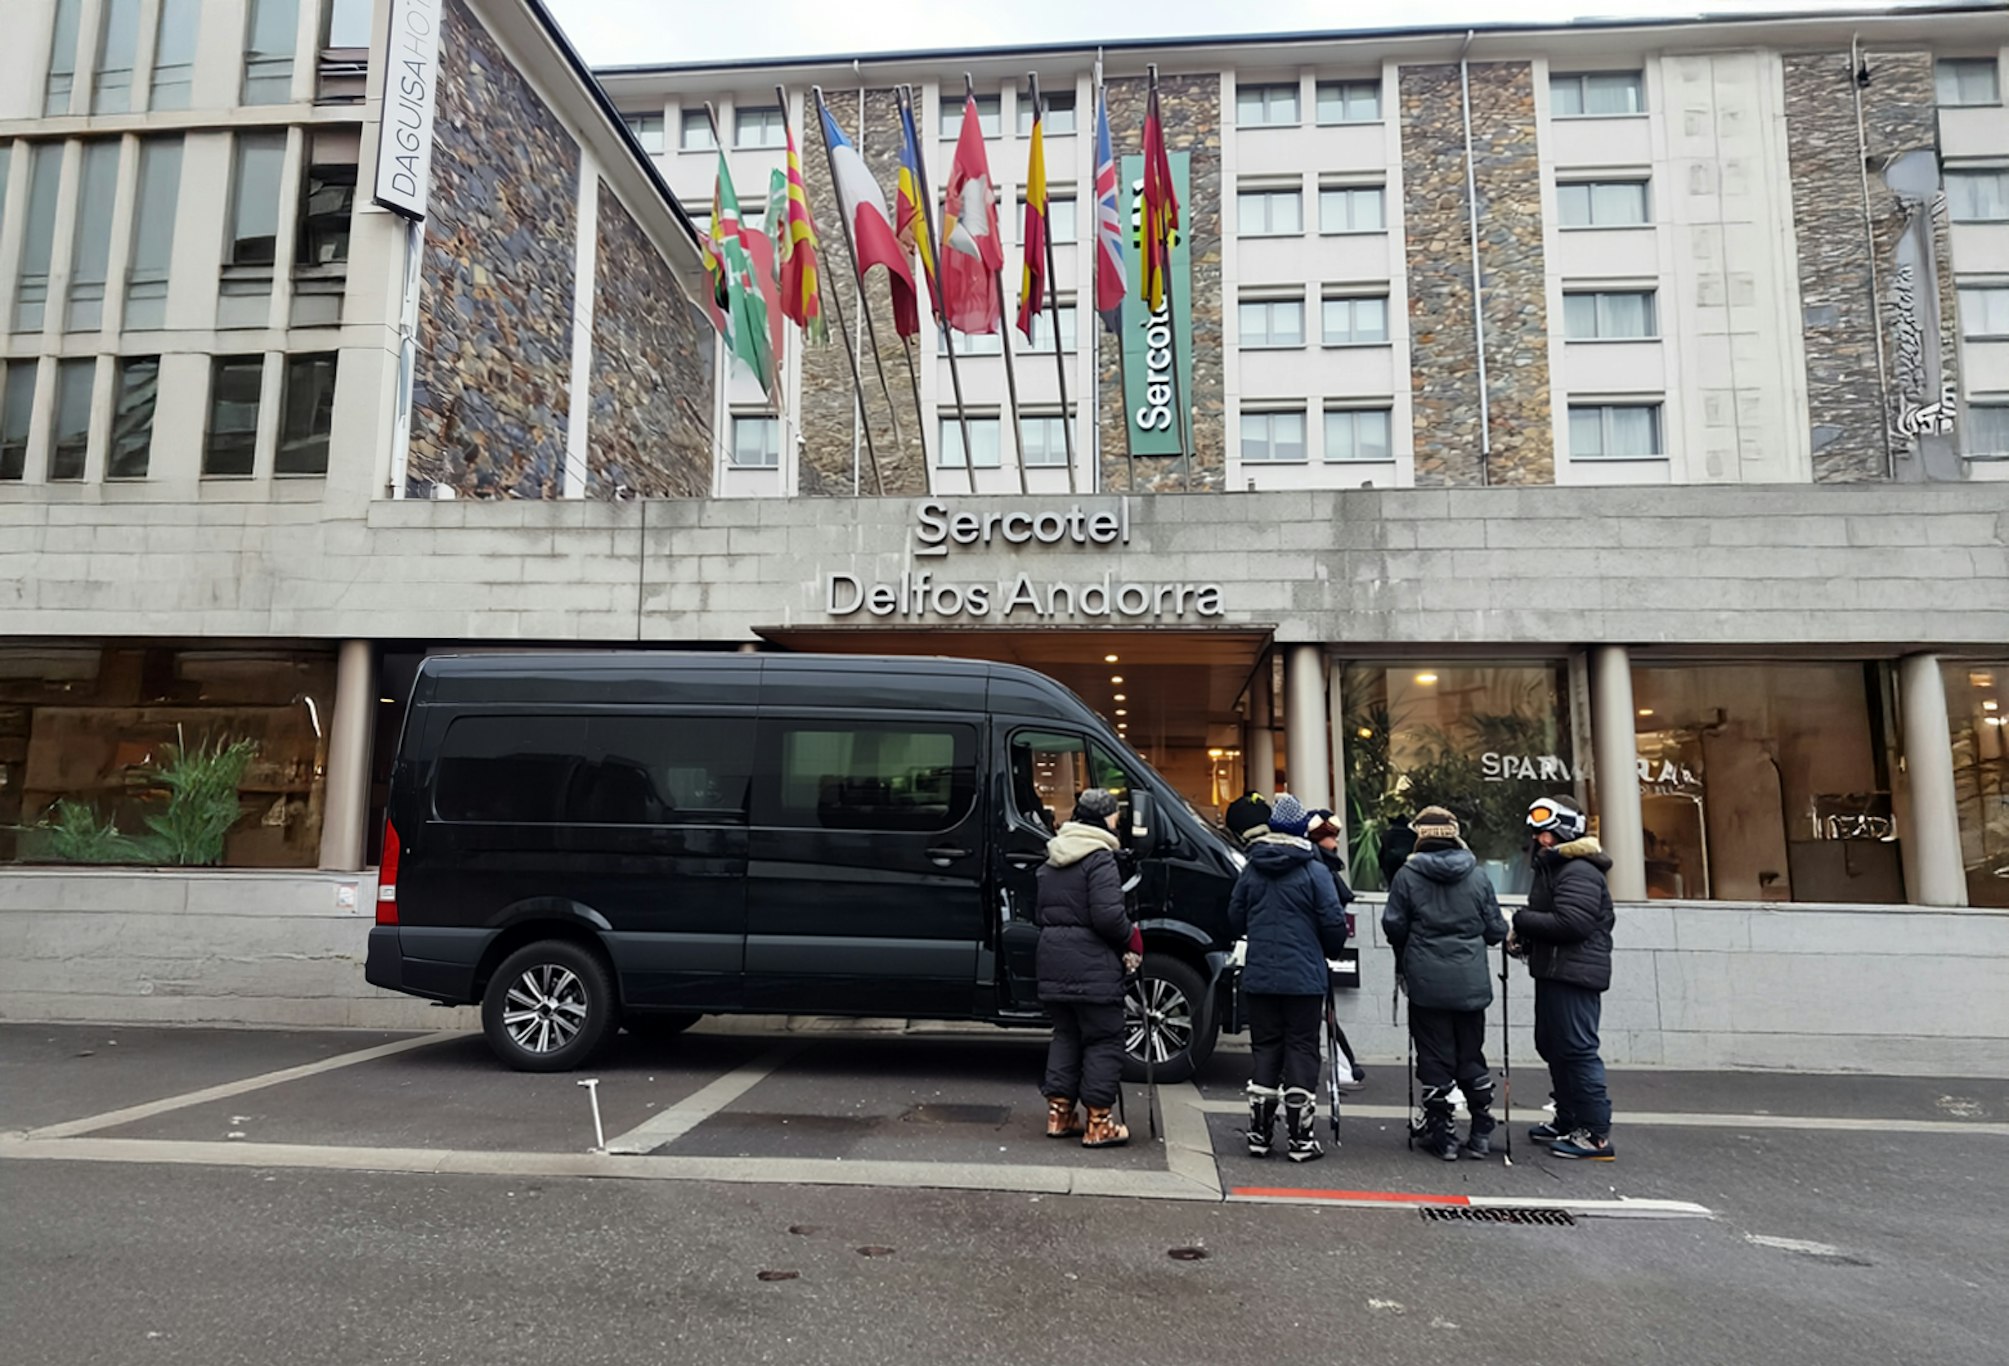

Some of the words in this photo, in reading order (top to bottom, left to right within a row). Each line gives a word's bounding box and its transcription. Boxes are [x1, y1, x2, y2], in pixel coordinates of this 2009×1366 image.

[392, 60, 428, 198] DAGUISA
[914, 496, 1130, 545] Sercotel
[825, 570, 991, 617] Delfos
[1003, 570, 1226, 617] Andorra
